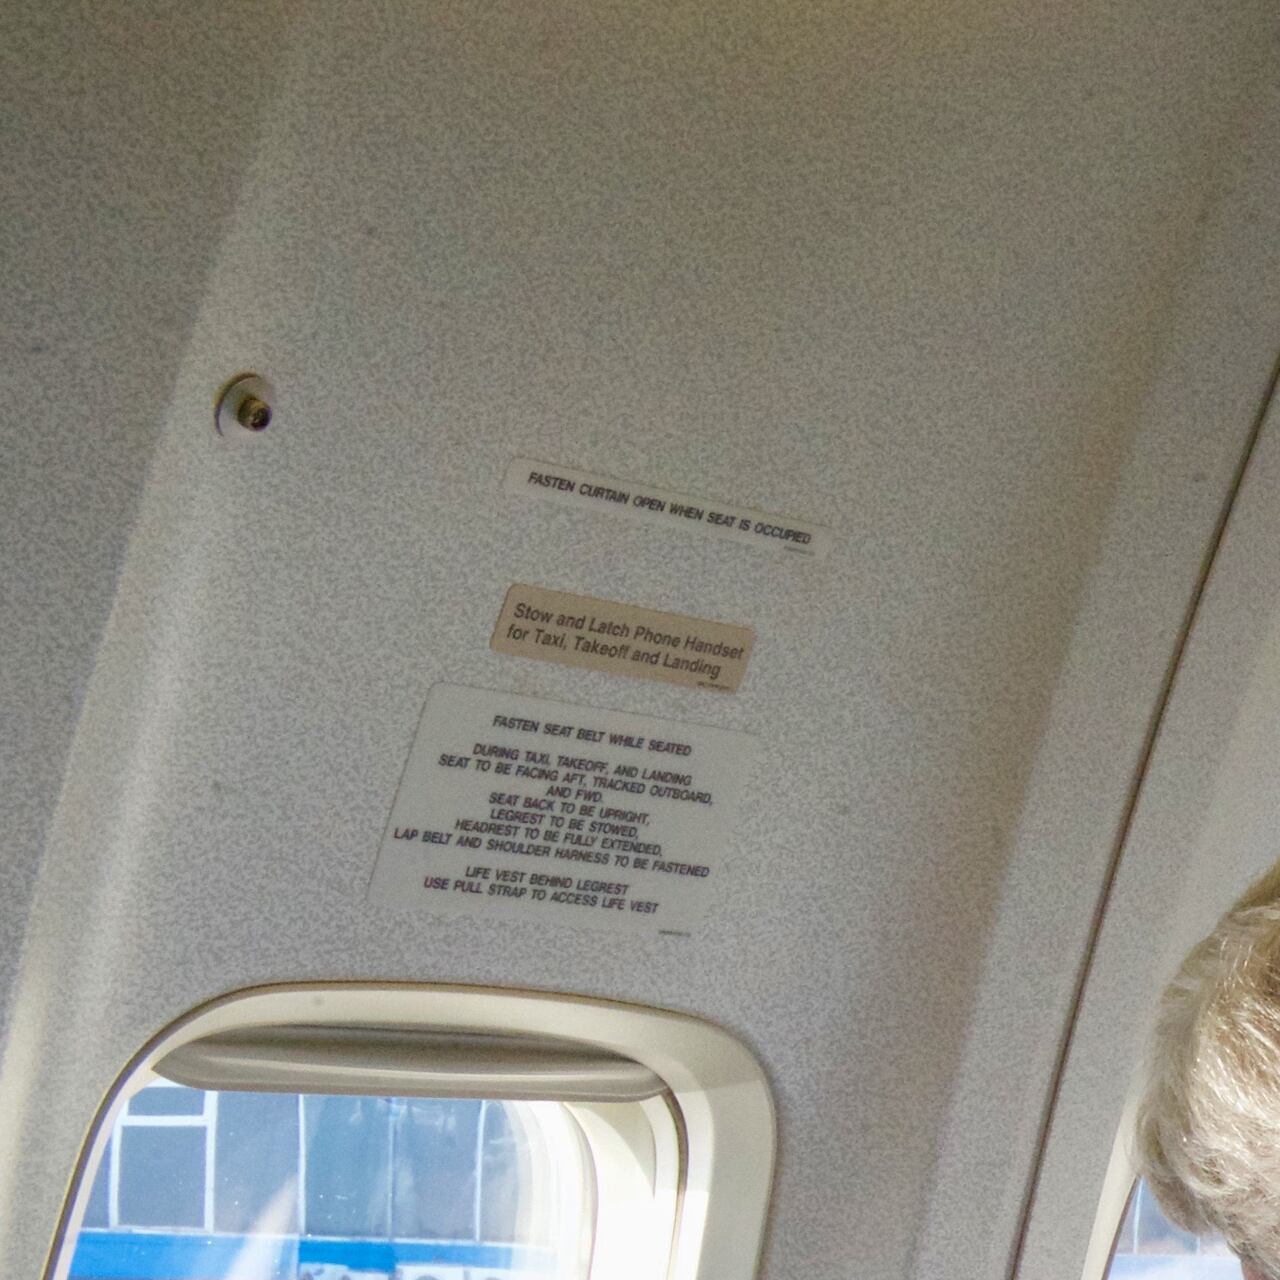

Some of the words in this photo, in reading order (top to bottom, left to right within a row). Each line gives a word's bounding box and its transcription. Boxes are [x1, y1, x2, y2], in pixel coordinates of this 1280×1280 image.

[527, 471, 576, 493] FASTEN
[579, 483, 631, 505] CURTAIN
[632, 495, 665, 513] OPEN
[669, 503, 704, 521] WHEN
[707, 511, 736, 528] SEAT
[738, 518, 751, 532] IS
[754, 522, 812, 546] OCCUPIED
[513, 602, 554, 624] Stow
[556, 610, 587, 630] and
[588, 617, 631, 639] Latch
[633, 625, 681, 649] Phone
[684, 635, 745, 661] Handset
[506, 624, 531, 642] for
[534, 629, 568, 651] Taxi,
[573, 636, 630, 661] Takeoff
[631, 648, 660, 666] and
[662, 652, 722, 681] Landing
[492, 715, 541, 733] FASTEN
[543, 722, 575, 738] SEAT
[576, 727, 605, 744] BELT
[609, 733, 645, 750] WHILE
[648, 738, 693, 758] SEATED
[438, 753, 471, 770] SEAT
[475, 758, 492, 772] TO
[495, 762, 512, 775] BE
[514, 765, 559, 784] FACING
[592, 776, 646, 794] TRACKED
[472, 743, 521, 761] DURING
[613, 764, 639, 779] AND
[641, 768, 693, 786] LANDING
[489, 792, 520, 807] SEAT
[523, 796, 556, 812] BACK
[560, 801, 576, 815] TO
[579, 804, 596, 817] BE
[546, 786, 572, 799] AND
[454, 819, 521, 837] HEADREST
[524, 827, 540, 841] TO
[543, 830, 560, 844] BE
[563, 832, 598, 848] FULLY
[490, 808, 546, 826] LEGREST
[550, 815, 565, 829] TO
[568, 818, 585, 831] BE
[394, 827, 419, 841] LAP
[422, 831, 453, 845] BELT
[456, 835, 482, 849] AND
[486, 838, 551, 857] SHOULDER
[554, 847, 610, 865] HARNESS
[614, 855, 630, 868] TO
[633, 858, 649, 870] BE
[652, 860, 711, 878] FASTENED
[424, 877, 451, 892] USE
[453, 880, 483, 894] PULL
[487, 883, 528, 899] STRAP
[531, 889, 547, 902] TO
[551, 891, 599, 907] ACCESS
[601, 898, 626, 911] LIFE
[629, 901, 660, 915] VEST
[465, 866, 492, 880] LIFE
[495, 870, 527, 885] VEST
[529, 873, 574, 890] BEHIND
[576, 879, 630, 895] LEGREST
